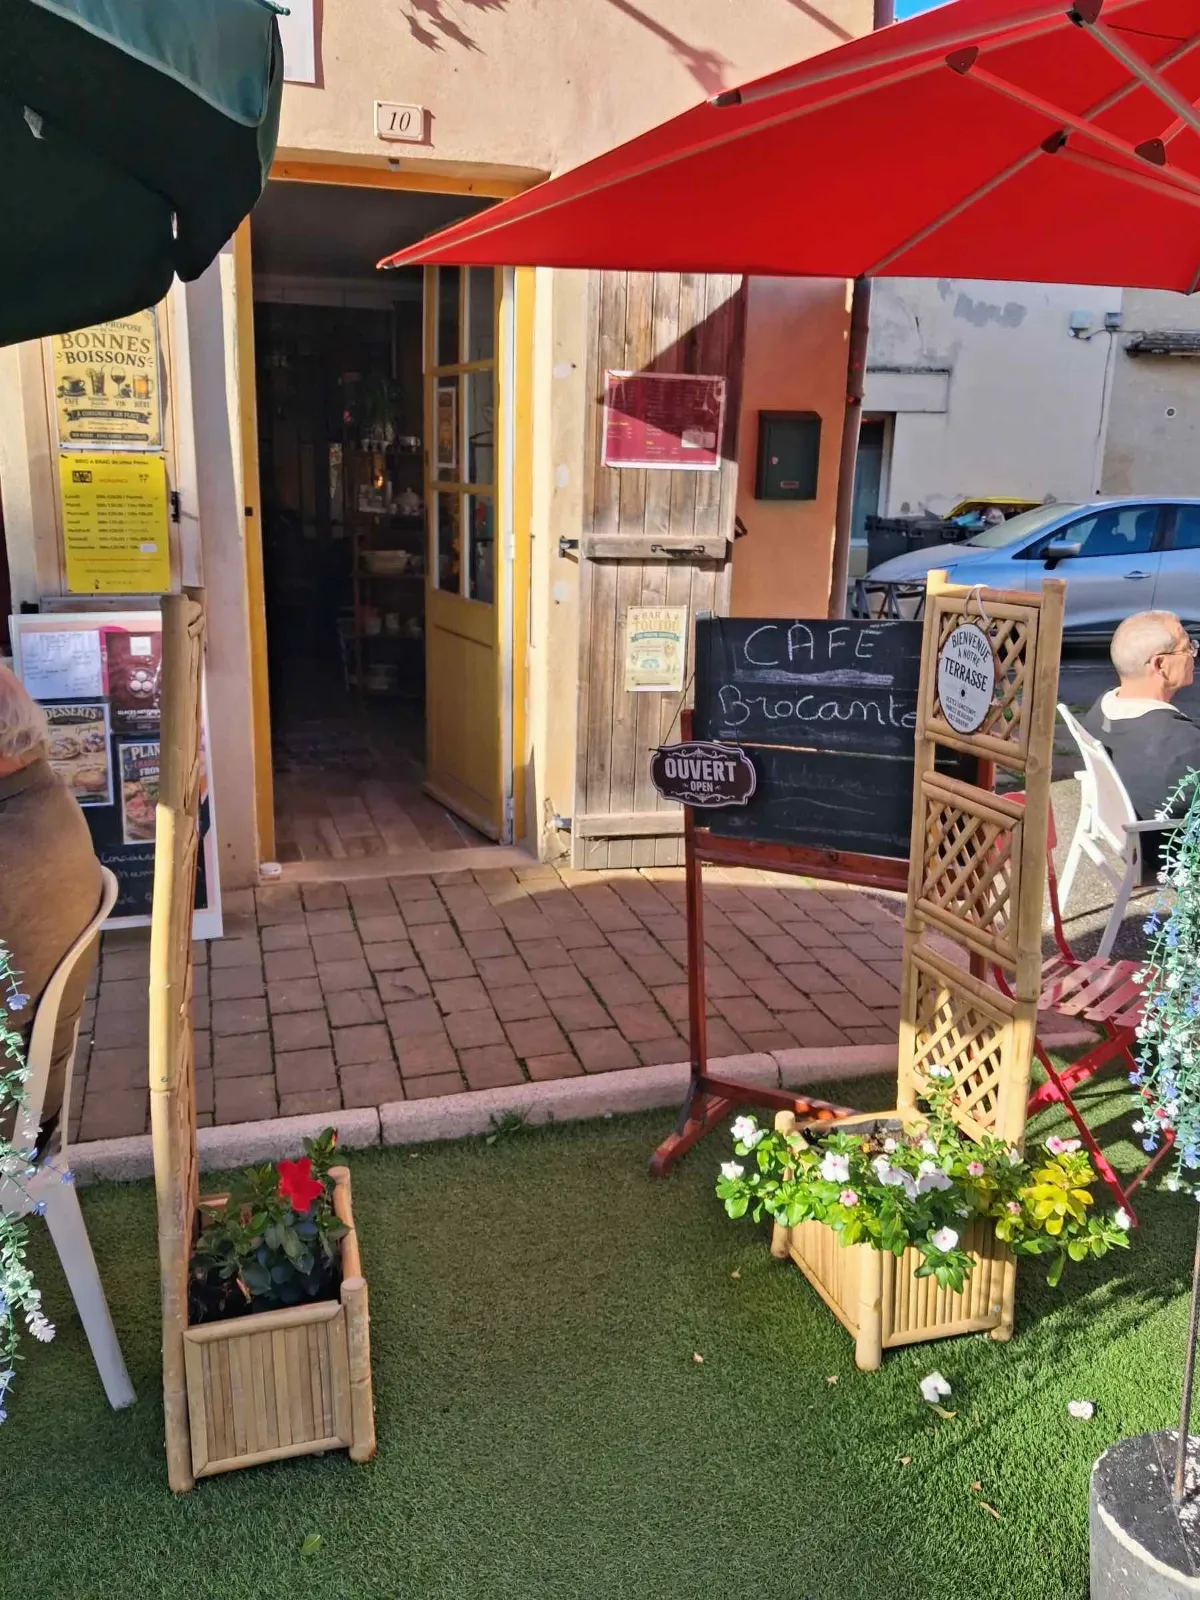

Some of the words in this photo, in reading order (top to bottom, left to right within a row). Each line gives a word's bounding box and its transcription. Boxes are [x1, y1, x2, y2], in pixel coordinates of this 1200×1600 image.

[388, 111, 411, 132] 10
[60, 332, 151, 354] BONNES
[65, 350, 146, 368] BOISSONS
[952, 631, 990, 663] BIENVENUE
[963, 649, 980, 667] NOTRE
[945, 657, 988, 692] TERRASSE
[45, 707, 97, 720] DESSERTS
[664, 758, 737, 782] OUVERT
[690, 781, 713, 792] OPEN
